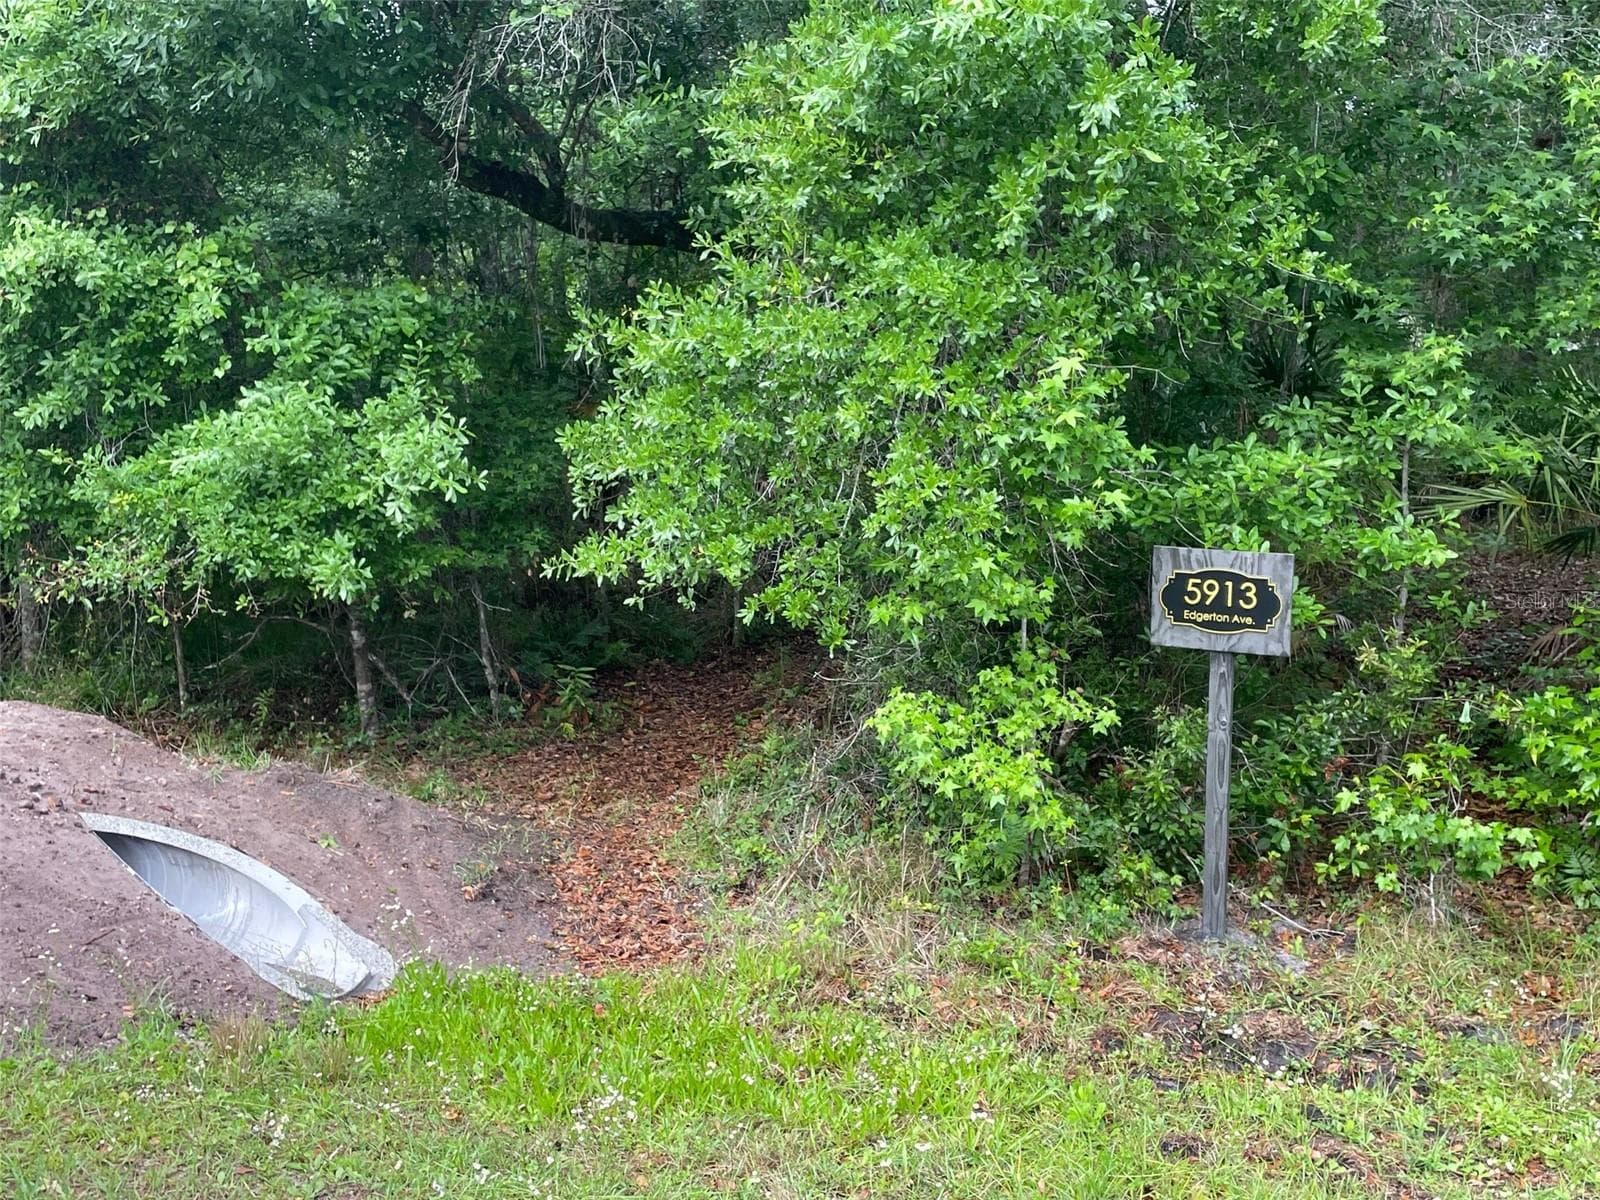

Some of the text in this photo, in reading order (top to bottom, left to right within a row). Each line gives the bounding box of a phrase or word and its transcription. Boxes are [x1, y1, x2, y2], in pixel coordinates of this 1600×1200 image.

[1184, 578, 1258, 609] 5913
[1183, 609, 1256, 625] Edgerton Ave.
